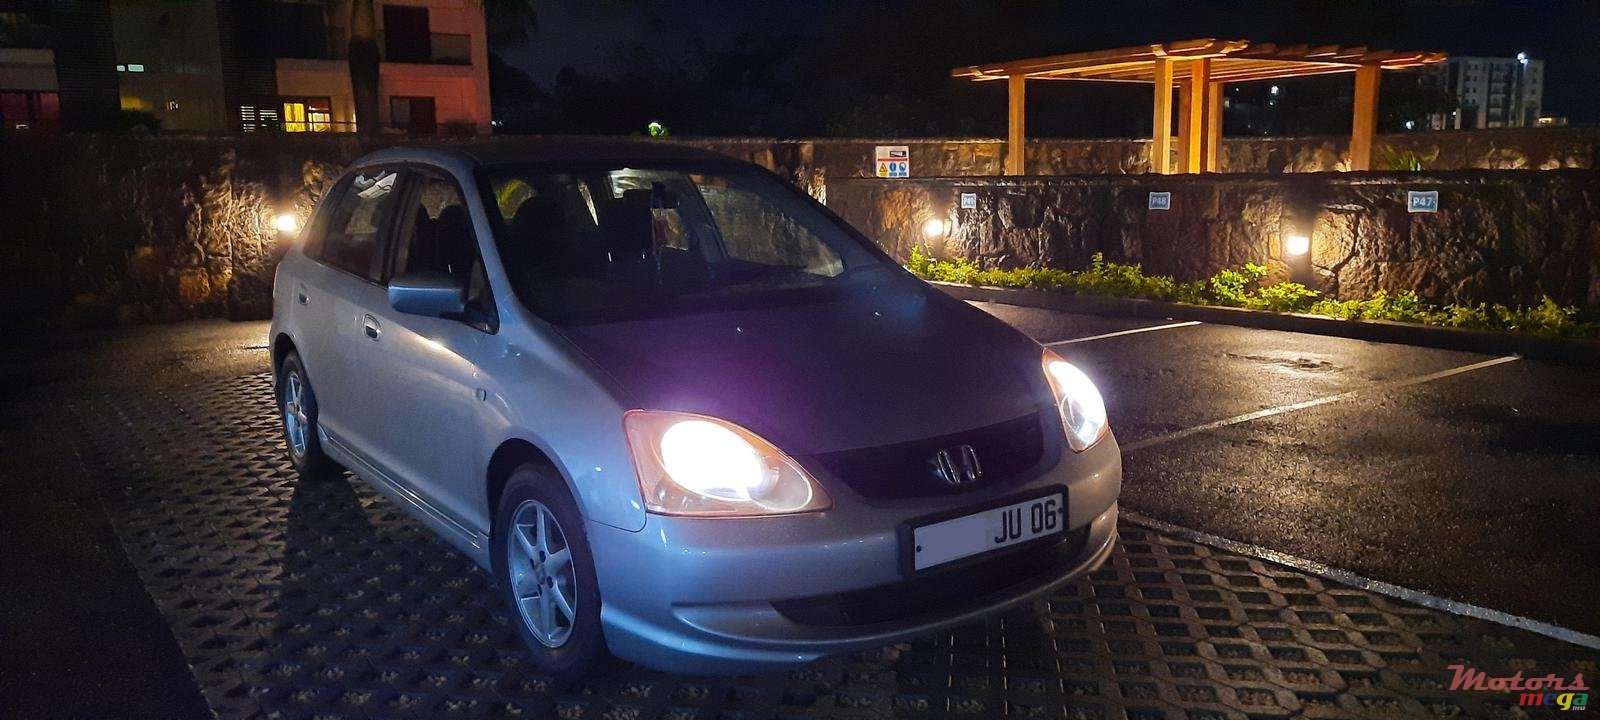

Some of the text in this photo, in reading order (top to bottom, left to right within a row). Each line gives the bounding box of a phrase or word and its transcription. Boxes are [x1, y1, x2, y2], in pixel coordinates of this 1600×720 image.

[1413, 196, 1433, 207] P47
[994, 499, 1057, 544] JU 06
